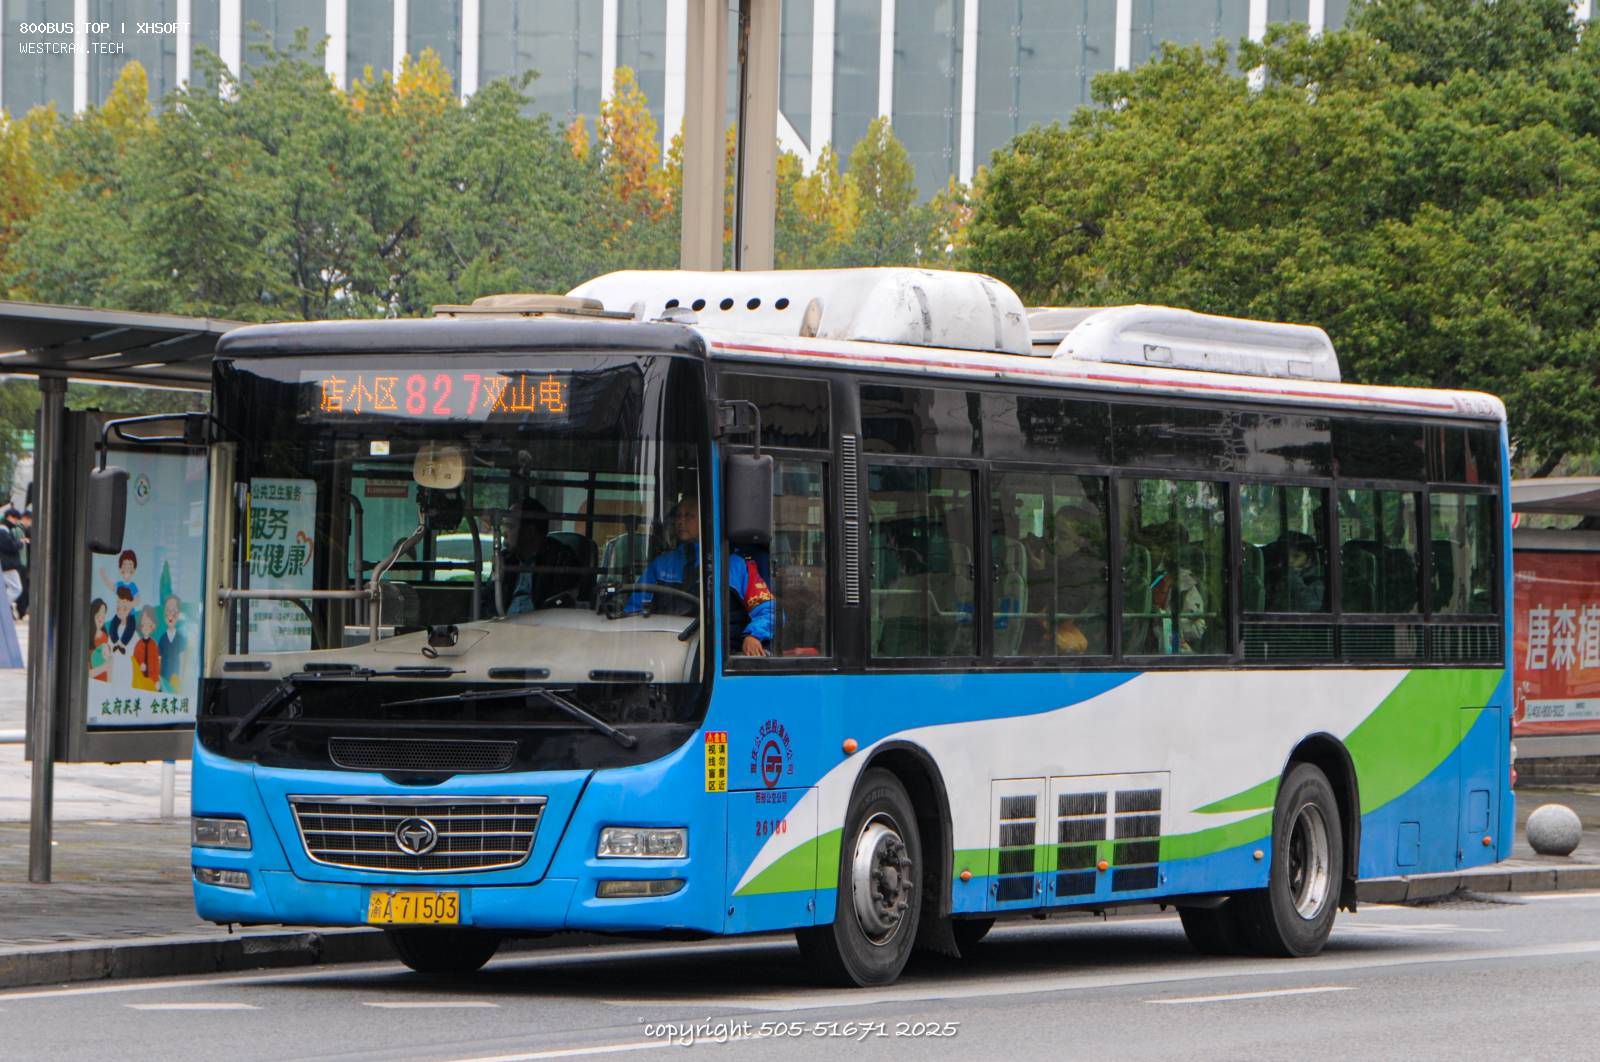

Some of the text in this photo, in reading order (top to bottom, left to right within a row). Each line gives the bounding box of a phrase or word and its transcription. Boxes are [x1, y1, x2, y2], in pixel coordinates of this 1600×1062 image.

[319, 374, 399, 414] 店小区
[405, 373, 481, 415] 827
[1525, 603, 1600, 672] 唐森植
